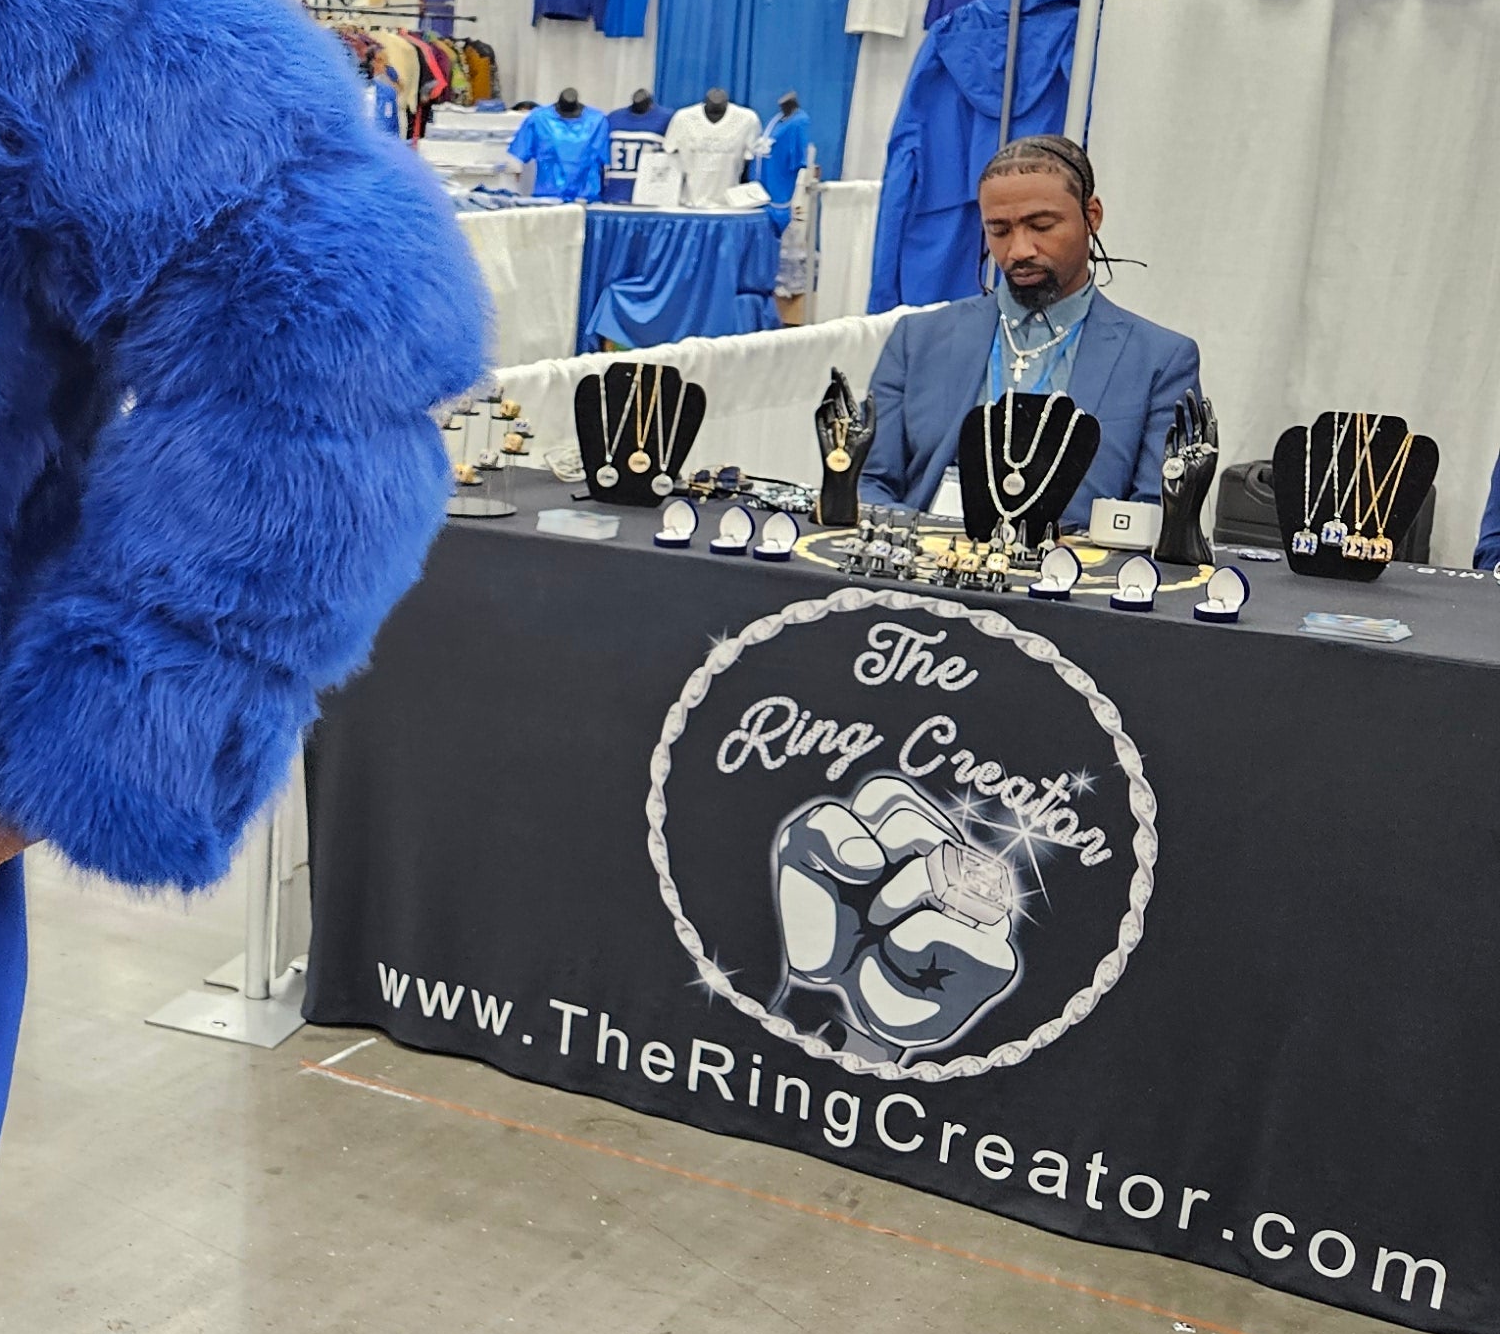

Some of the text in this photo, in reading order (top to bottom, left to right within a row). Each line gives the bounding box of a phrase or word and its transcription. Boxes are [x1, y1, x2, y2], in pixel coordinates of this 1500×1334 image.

[853, 621, 979, 691] The
[716, 695, 1113, 866] Ring Creator
[377, 961, 1449, 1312] www.TheRingCreator.com
